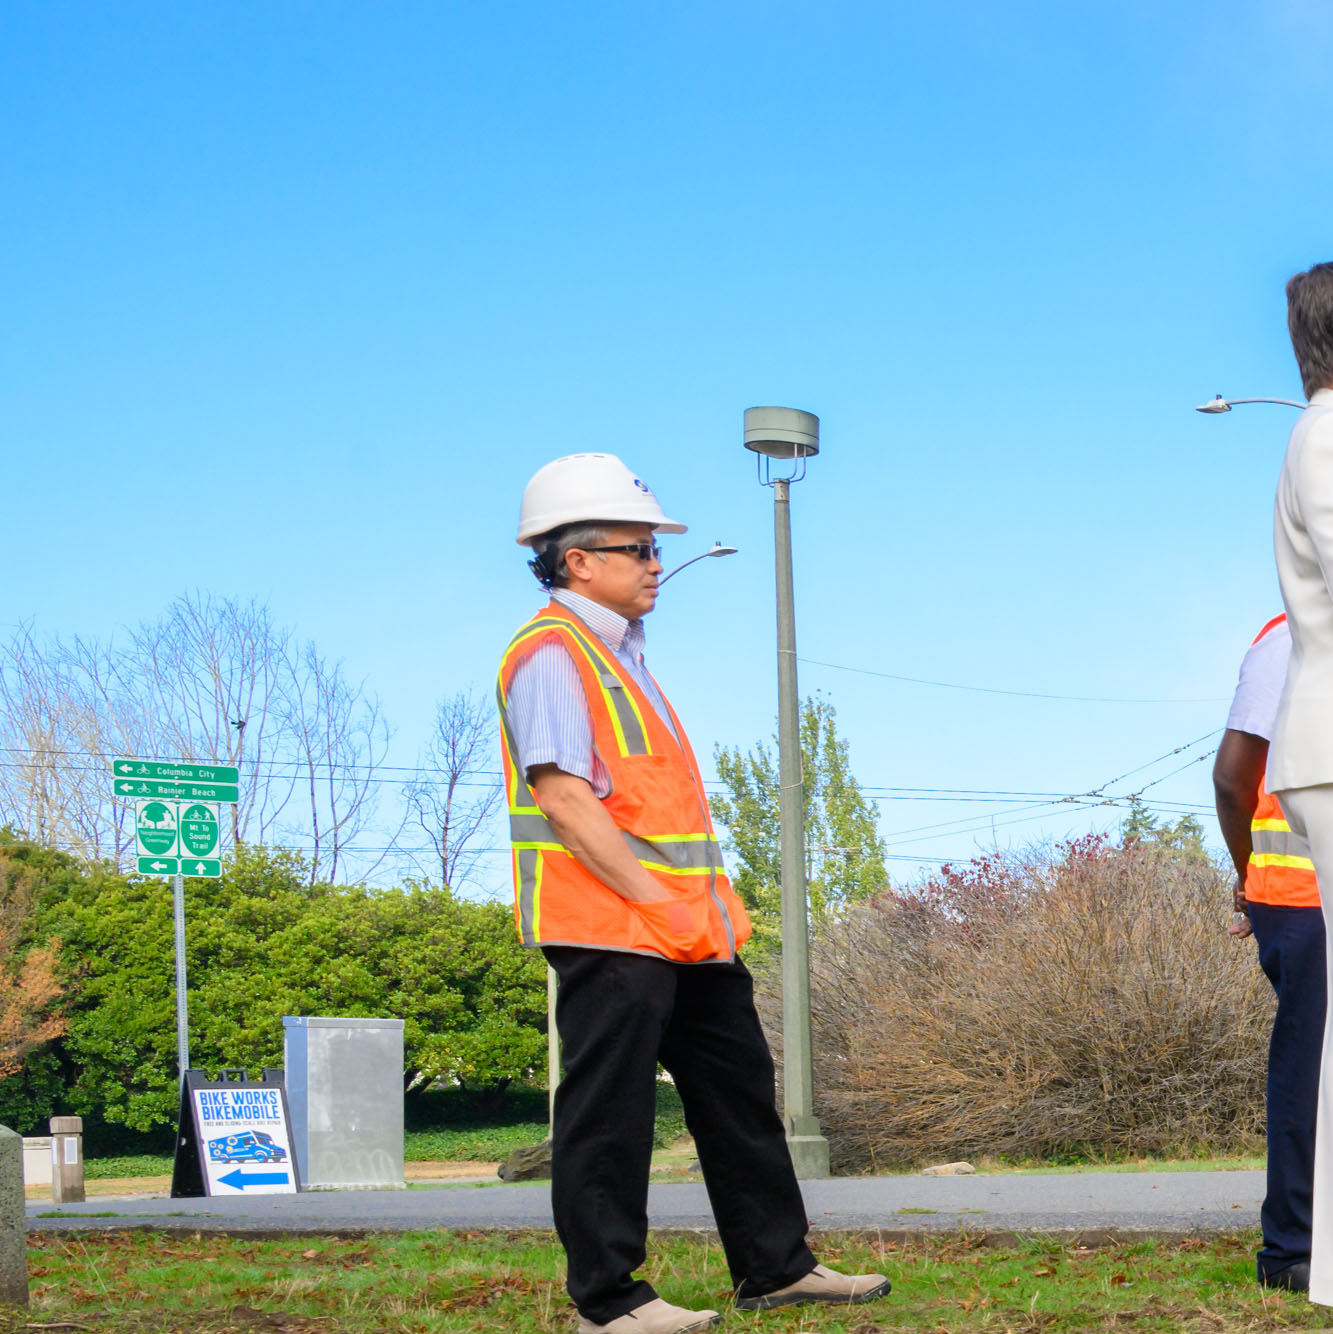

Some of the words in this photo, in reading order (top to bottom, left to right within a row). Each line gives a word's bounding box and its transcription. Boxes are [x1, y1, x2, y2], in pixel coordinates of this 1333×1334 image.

[157, 767, 193, 777] Columbia
[199, 769, 215, 780] City
[158, 786, 186, 795] Rainier
[192, 788, 216, 797] Beach
[199, 1092, 229, 1105] BIKE
[231, 1091, 278, 1105] WORKS
[202, 1105, 281, 1120] BIKEMOBILE
